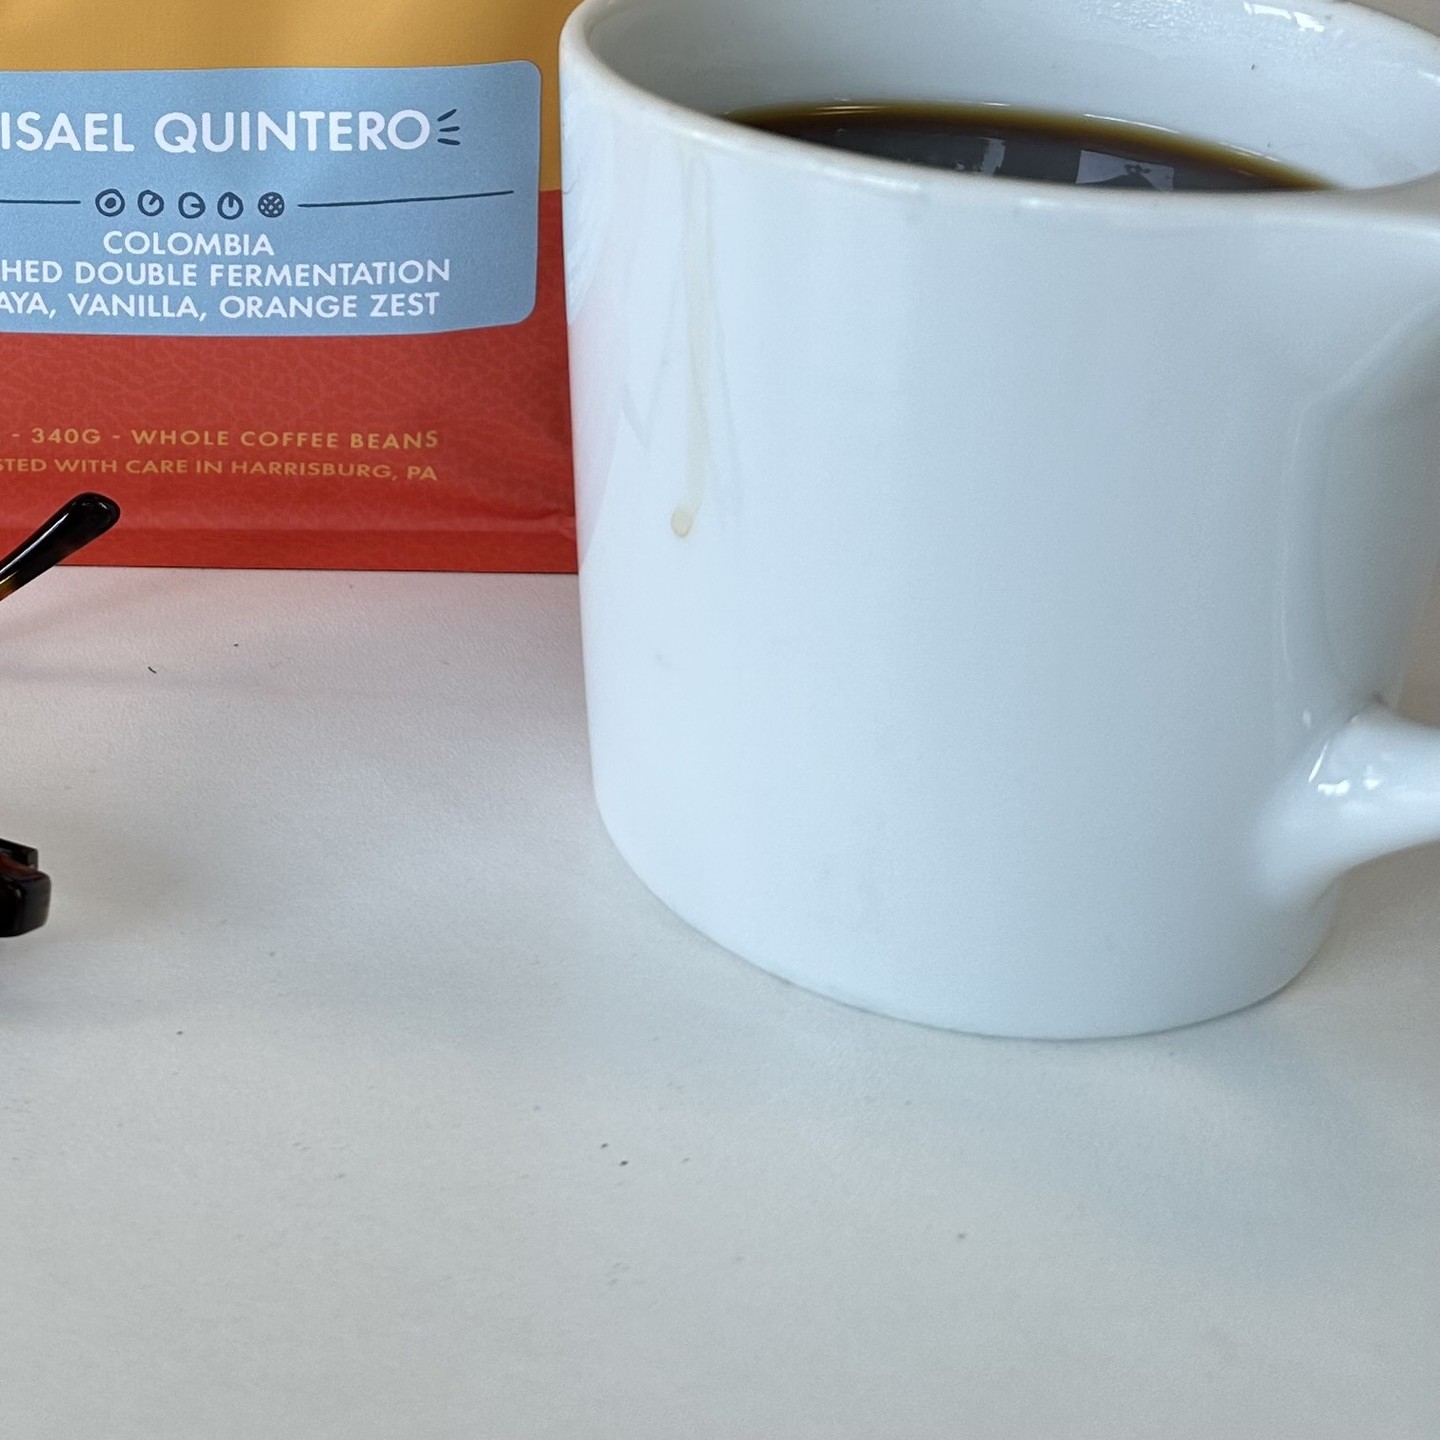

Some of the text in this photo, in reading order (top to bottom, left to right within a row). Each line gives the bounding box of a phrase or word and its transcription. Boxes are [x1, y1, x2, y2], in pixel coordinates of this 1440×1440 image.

[155, 110, 429, 153] QUINTERO
[104, 231, 274, 255] COLOMBIA
[76, 262, 196, 286] DOUBLE
[211, 260, 449, 286] FERMENTATION
[68, 293, 206, 321] VANILLA,
[220, 296, 357, 318] ORANGE
[370, 292, 439, 317] ZEST
[32, 428, 100, 444] 340G
[132, 430, 228, 445] WHOLE
[241, 431, 337, 448] COFFEE
[351, 431, 437, 449] BEANS
[54, 459, 117, 472] WITH
[126, 460, 186, 473] CARE
[197, 460, 222, 473] IN
[232, 462, 396, 480] HARRISBURG,
[407, 466, 437, 480] PA
